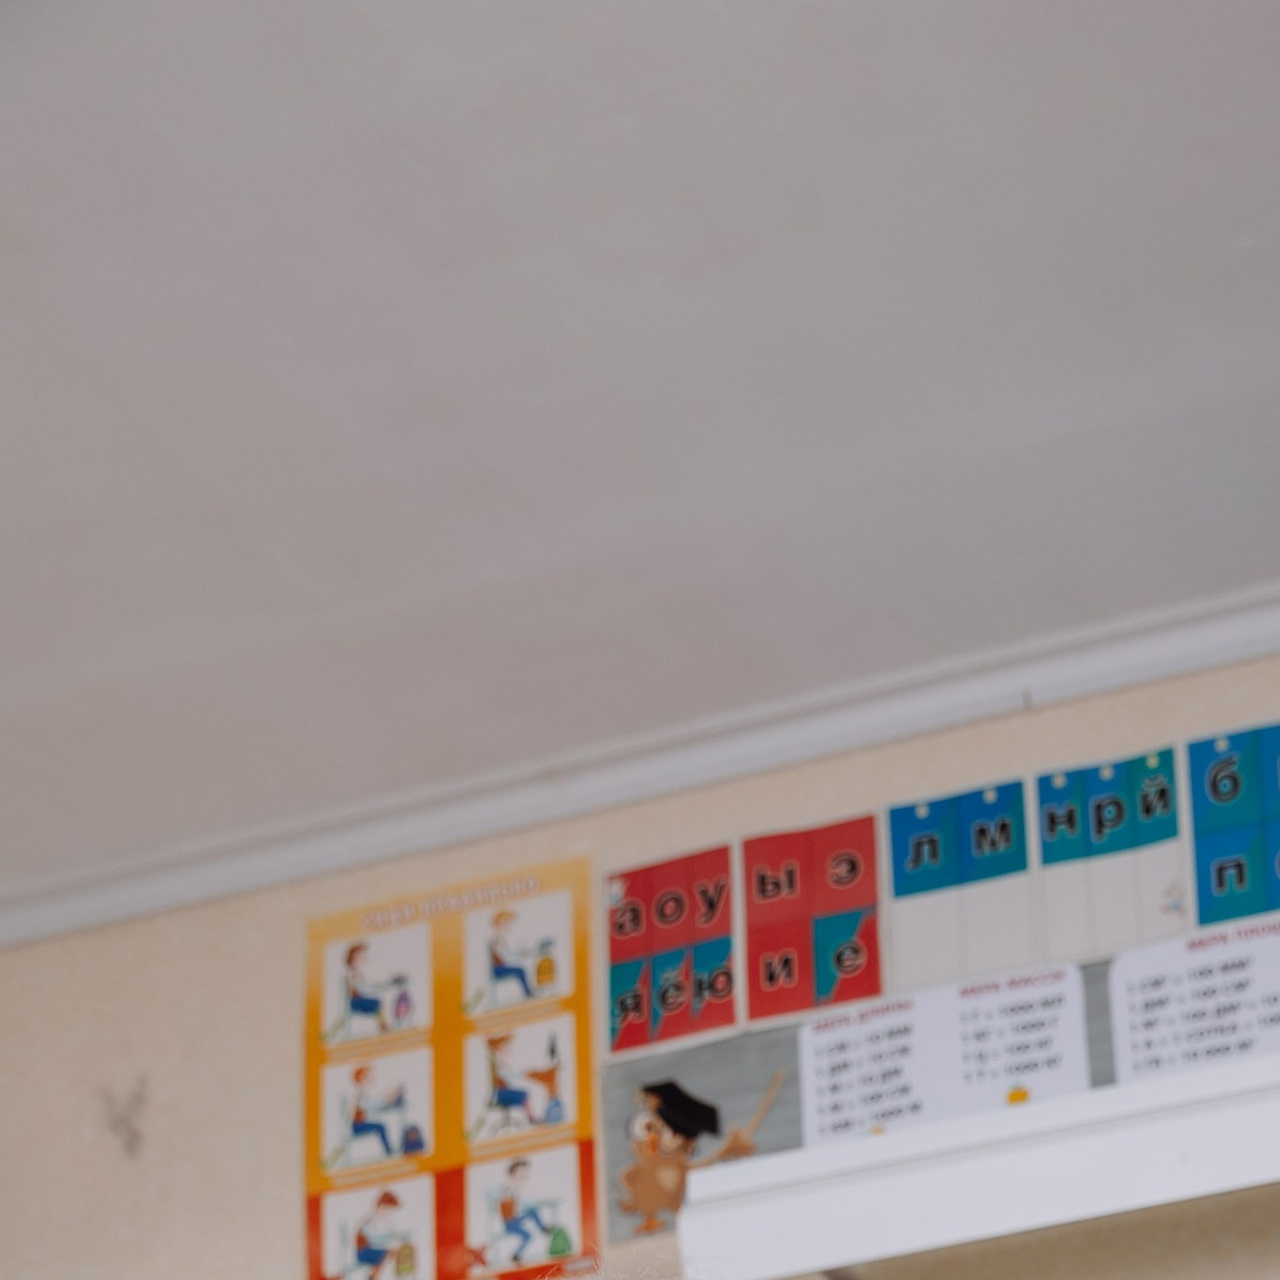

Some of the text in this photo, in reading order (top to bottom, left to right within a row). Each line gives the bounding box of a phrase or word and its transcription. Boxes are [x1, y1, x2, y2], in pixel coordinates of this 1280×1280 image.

[1208, 755, 1243, 803] б
[908, 772, 1171, 870] л м н р й
[612, 853, 860, 936] а о у ы э
[1214, 857, 1247, 894] п
[612, 940, 864, 1023] я ё ю и е
